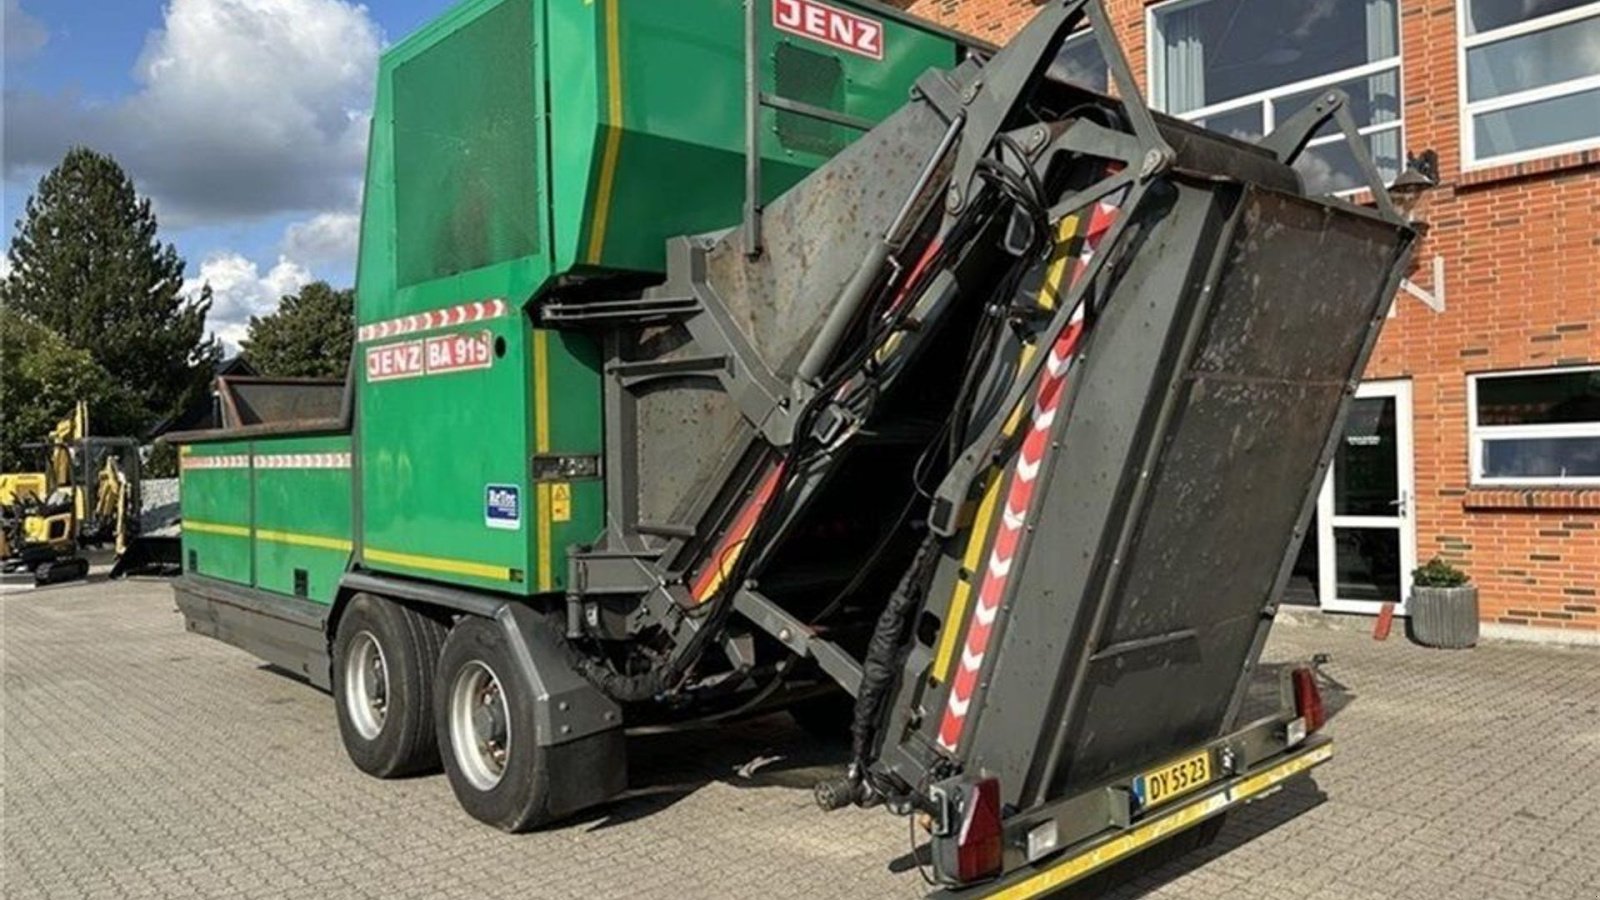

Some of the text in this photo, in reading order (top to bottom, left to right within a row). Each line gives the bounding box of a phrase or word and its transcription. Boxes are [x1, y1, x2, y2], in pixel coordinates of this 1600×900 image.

[779, 0, 877, 52] JENZ
[368, 337, 487, 375] JENZ BA 915
[1150, 757, 1206, 799] DY 55 23
